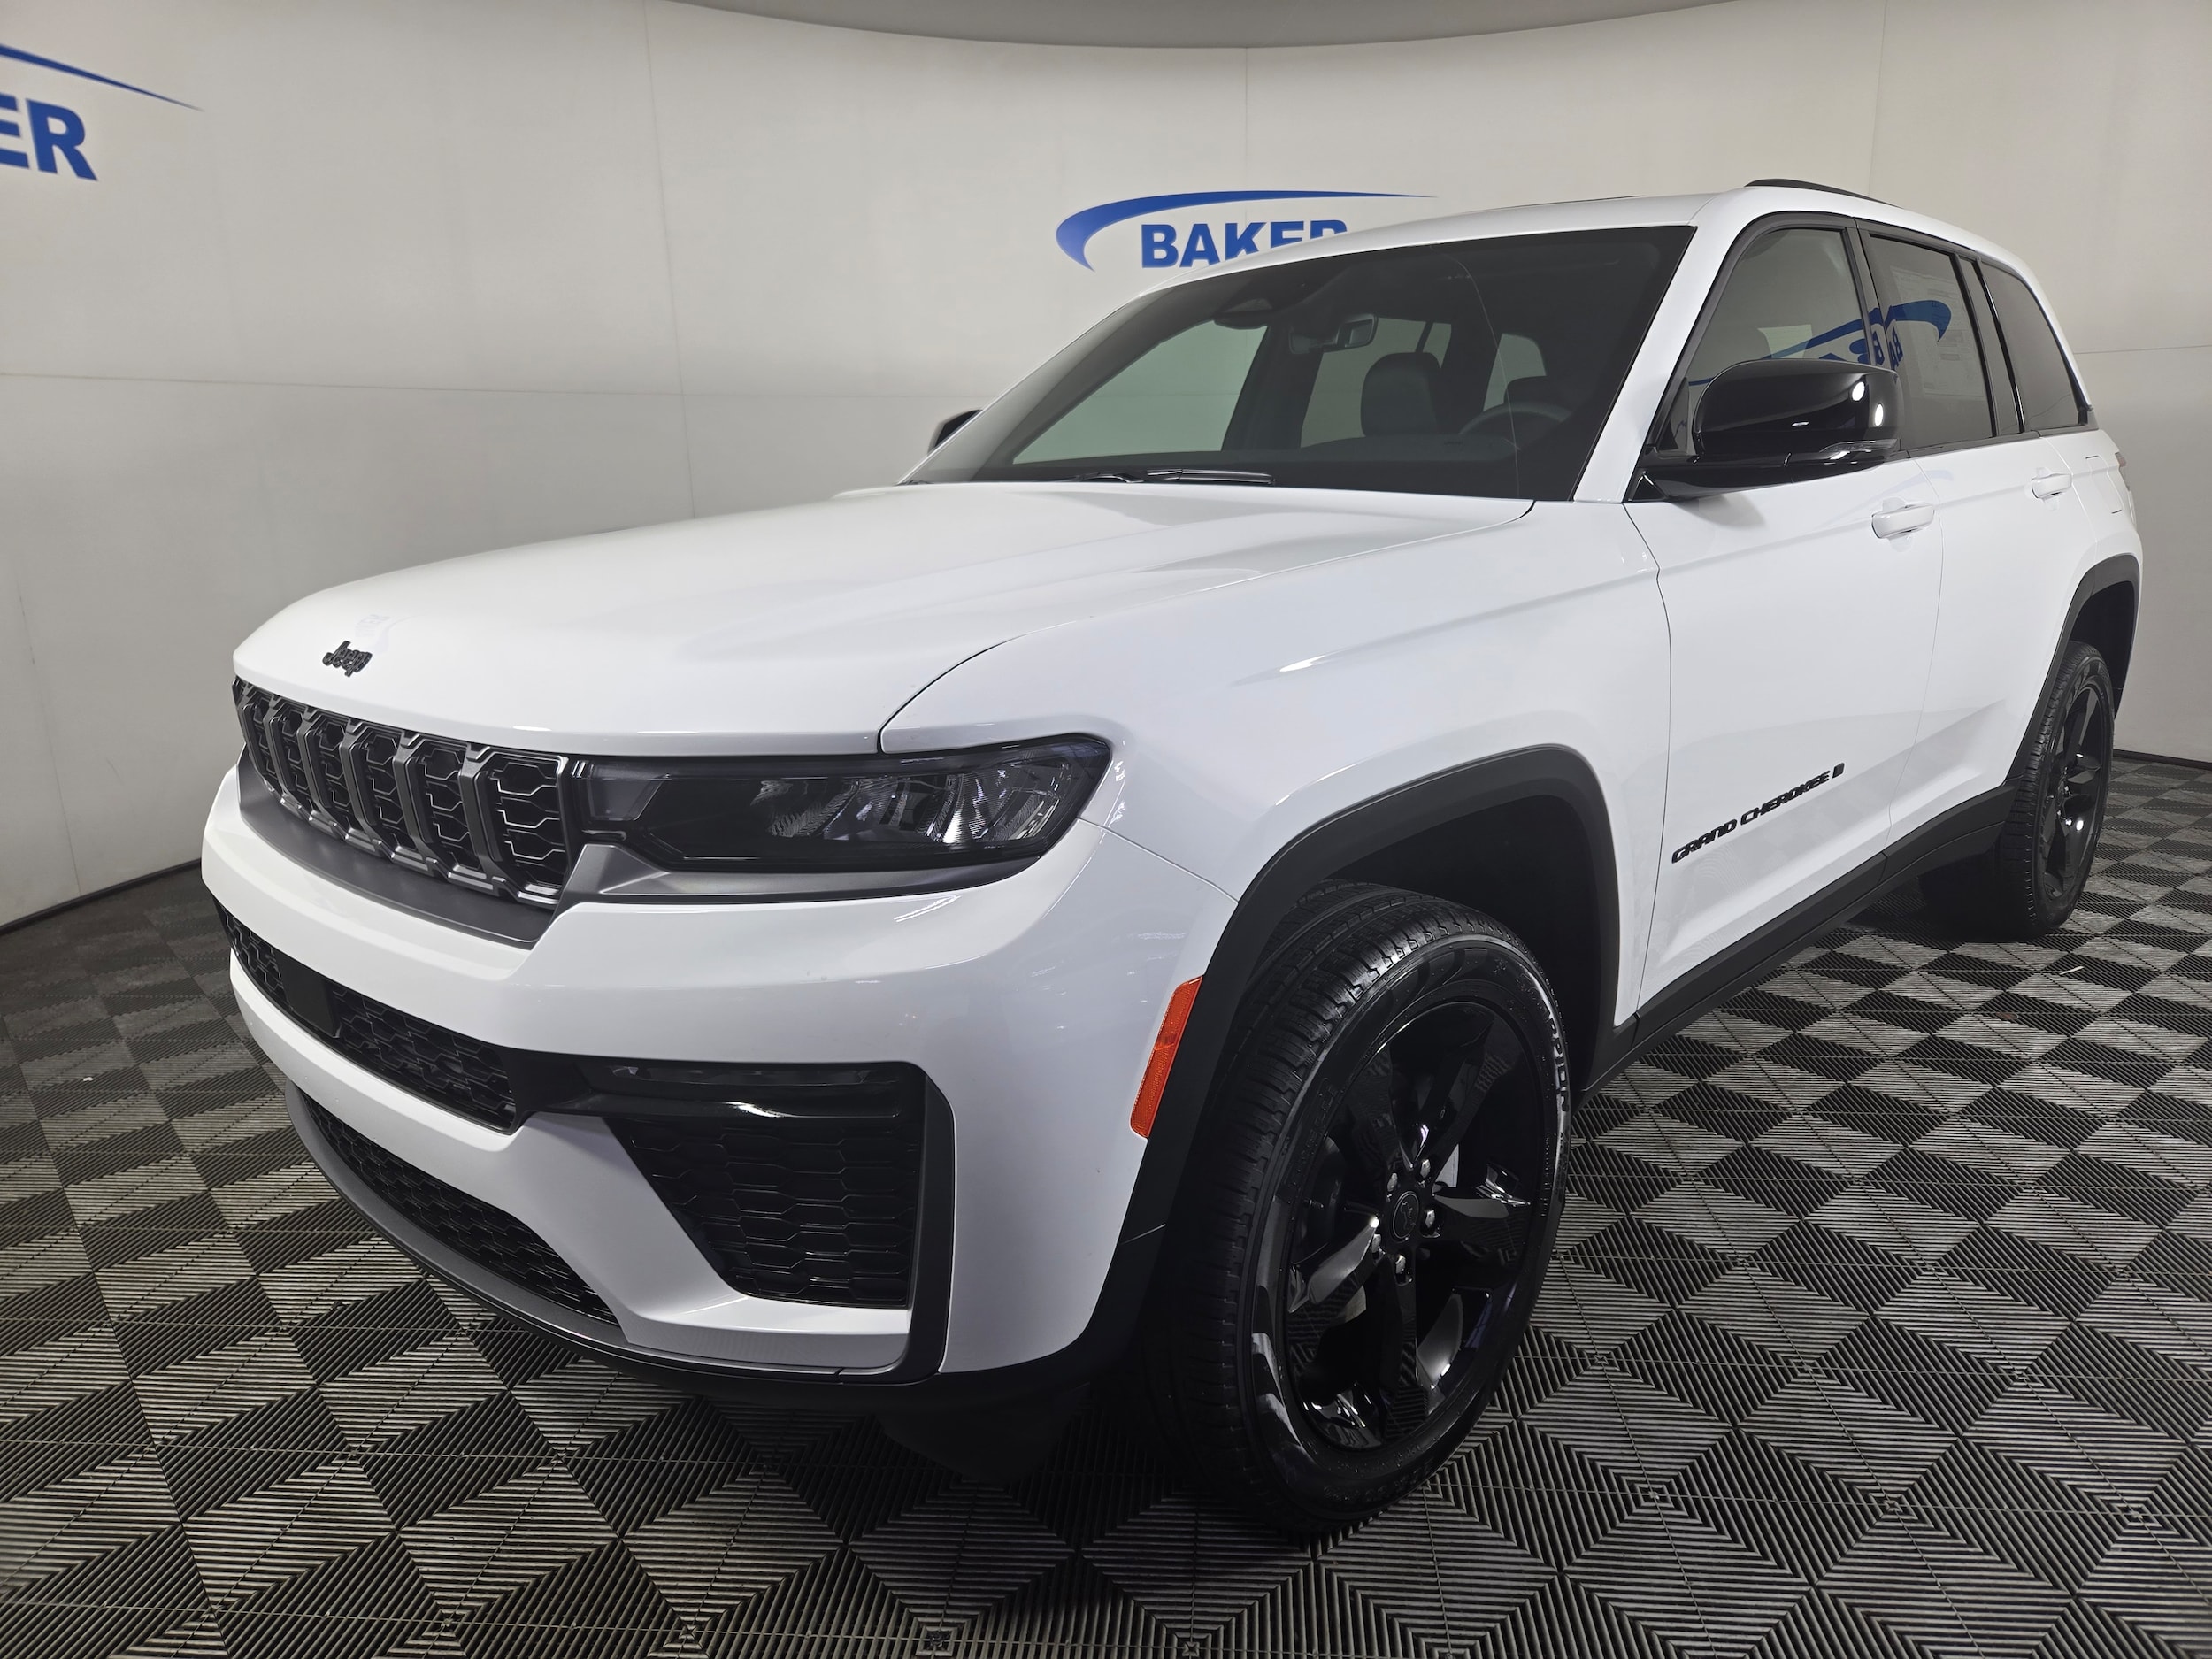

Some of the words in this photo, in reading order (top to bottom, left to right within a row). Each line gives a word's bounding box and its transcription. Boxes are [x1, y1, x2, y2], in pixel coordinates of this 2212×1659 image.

[322, 640, 373, 678] Jeep
[1671, 818, 1738, 864] GRAND
[1740, 770, 1831, 826] CHEROKEE
